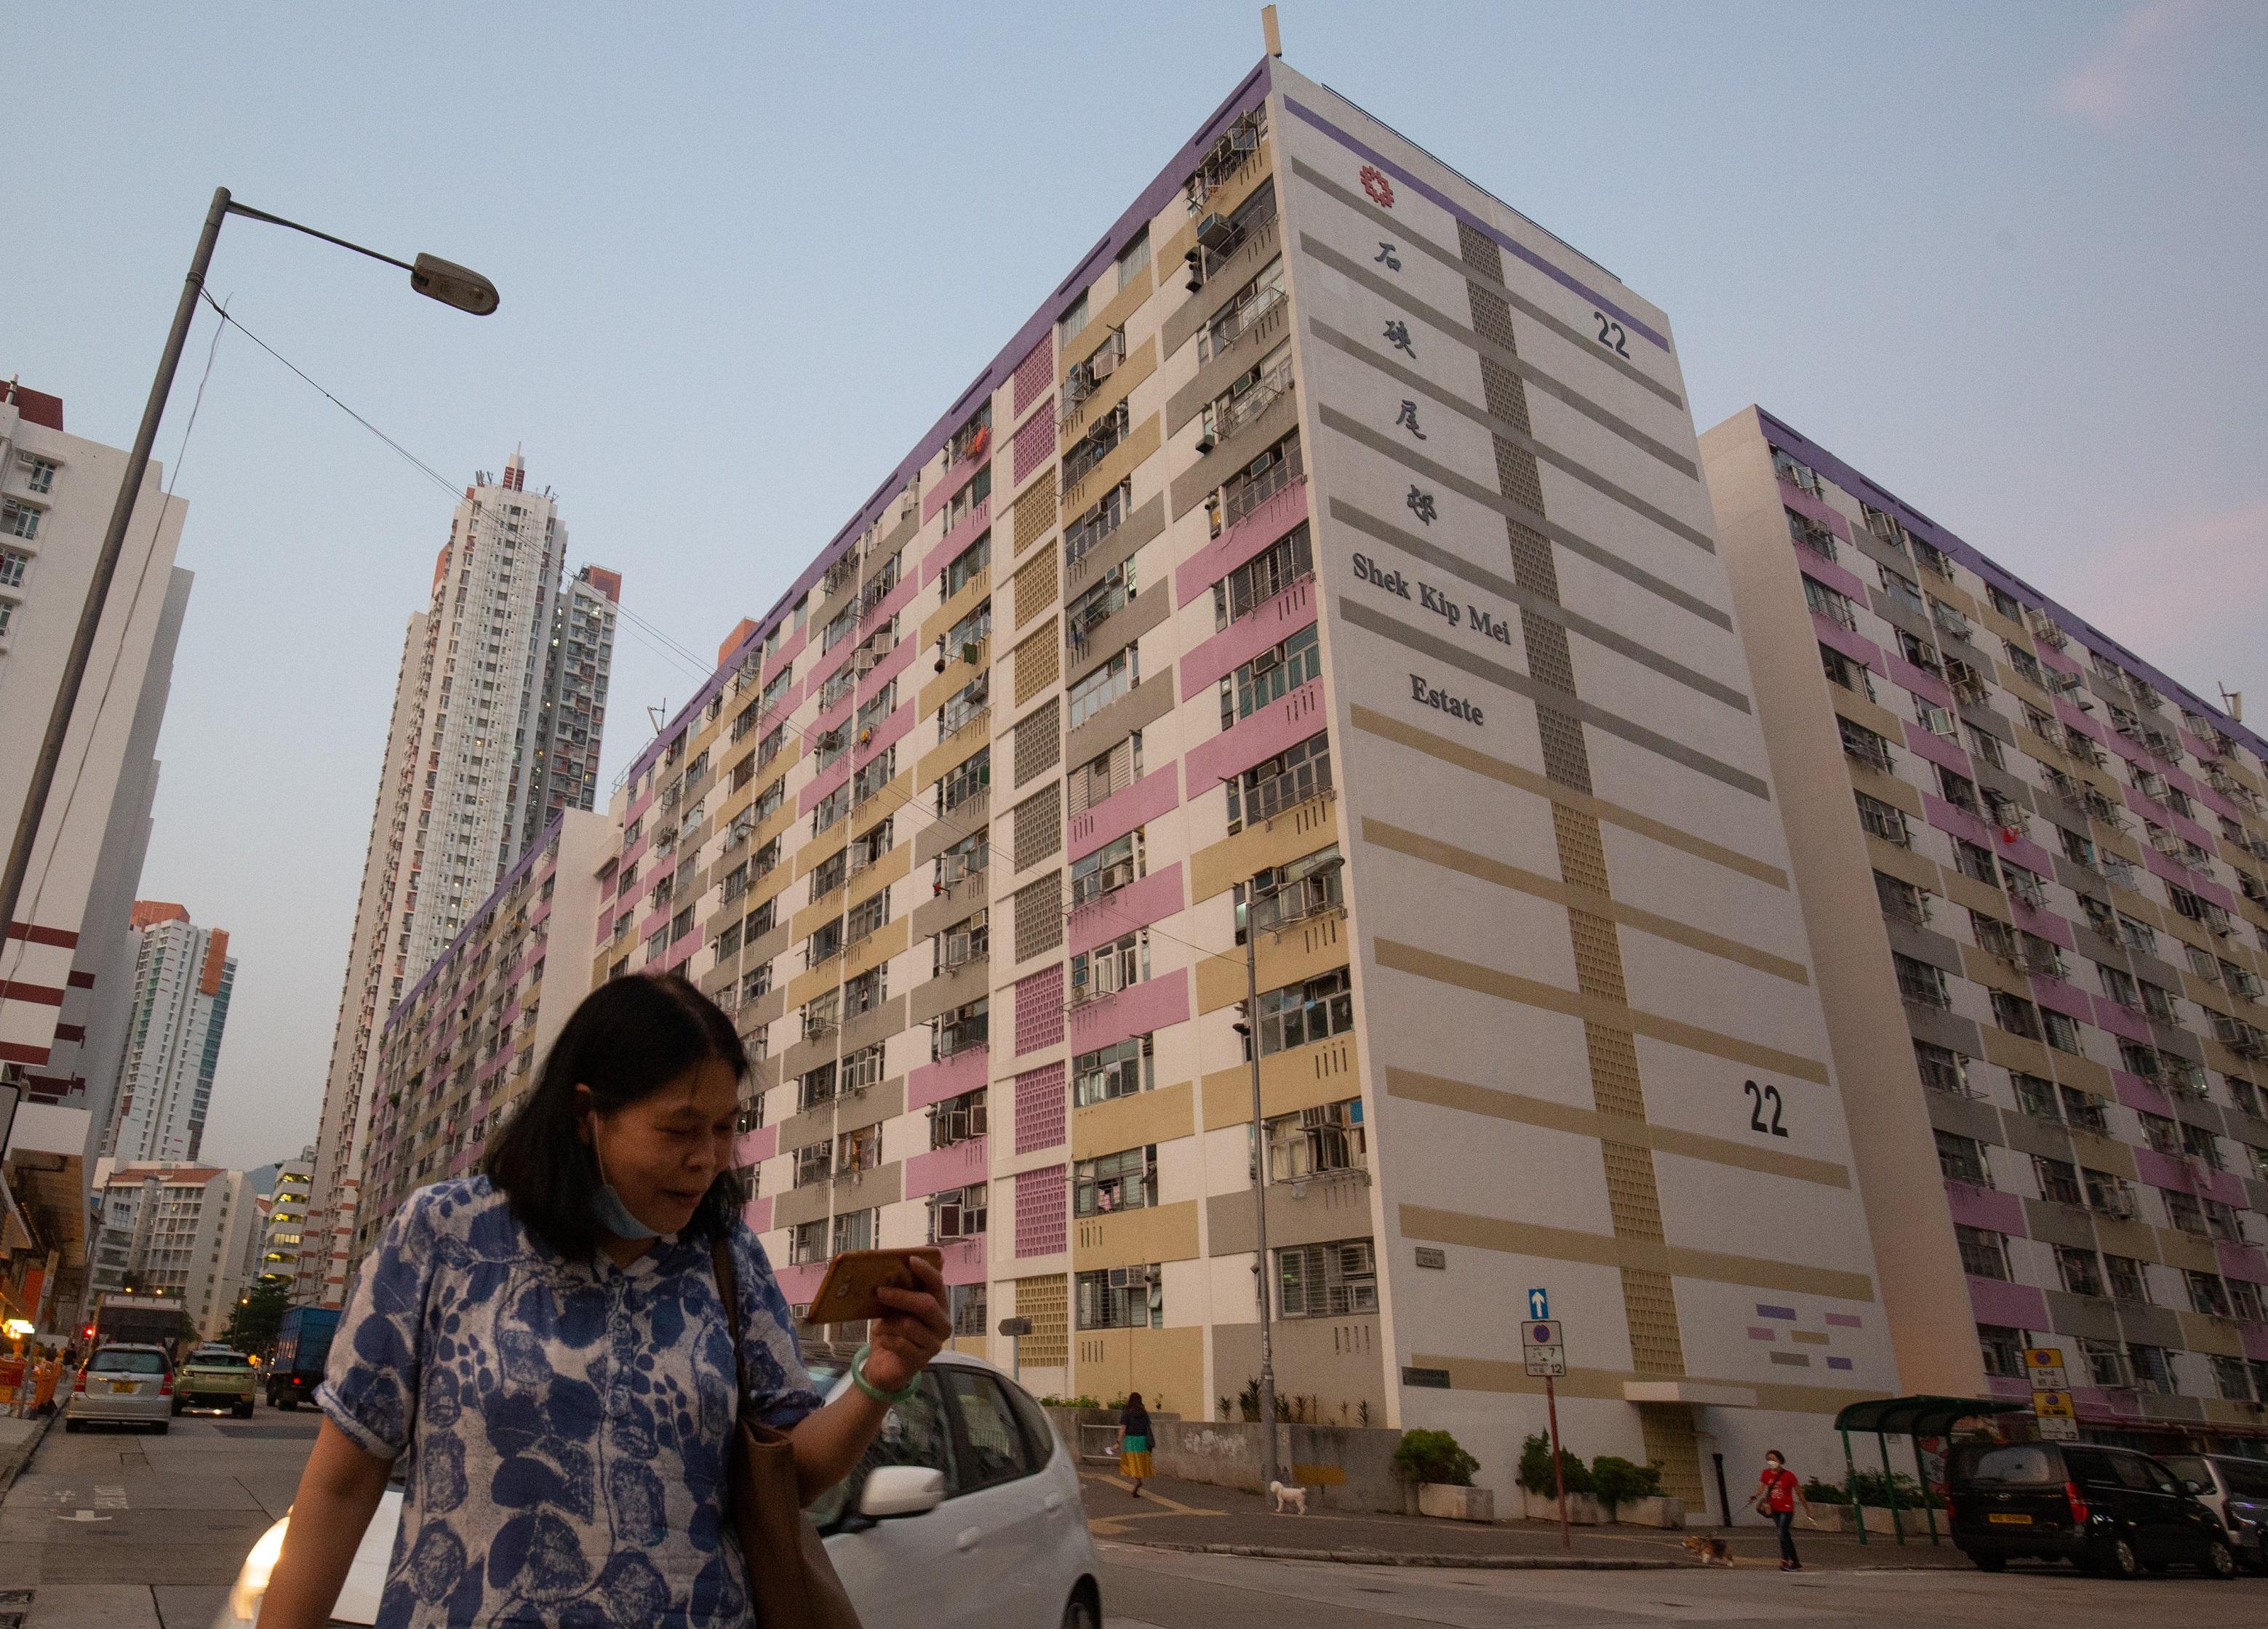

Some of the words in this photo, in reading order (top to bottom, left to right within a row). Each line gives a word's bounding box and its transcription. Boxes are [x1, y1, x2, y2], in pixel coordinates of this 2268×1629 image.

[1594, 311, 1631, 360] 22
[1373, 241, 1438, 526] 石硤尾邨
[1352, 551, 1412, 600] Shek
[1417, 581, 1461, 625] Kip
[1468, 604, 1512, 646] Mei
[1409, 673, 1485, 727] Estate
[1744, 1079, 1789, 1138] 22
[1549, 1348, 1555, 1357] 7
[1551, 1364, 1562, 1374] 12
